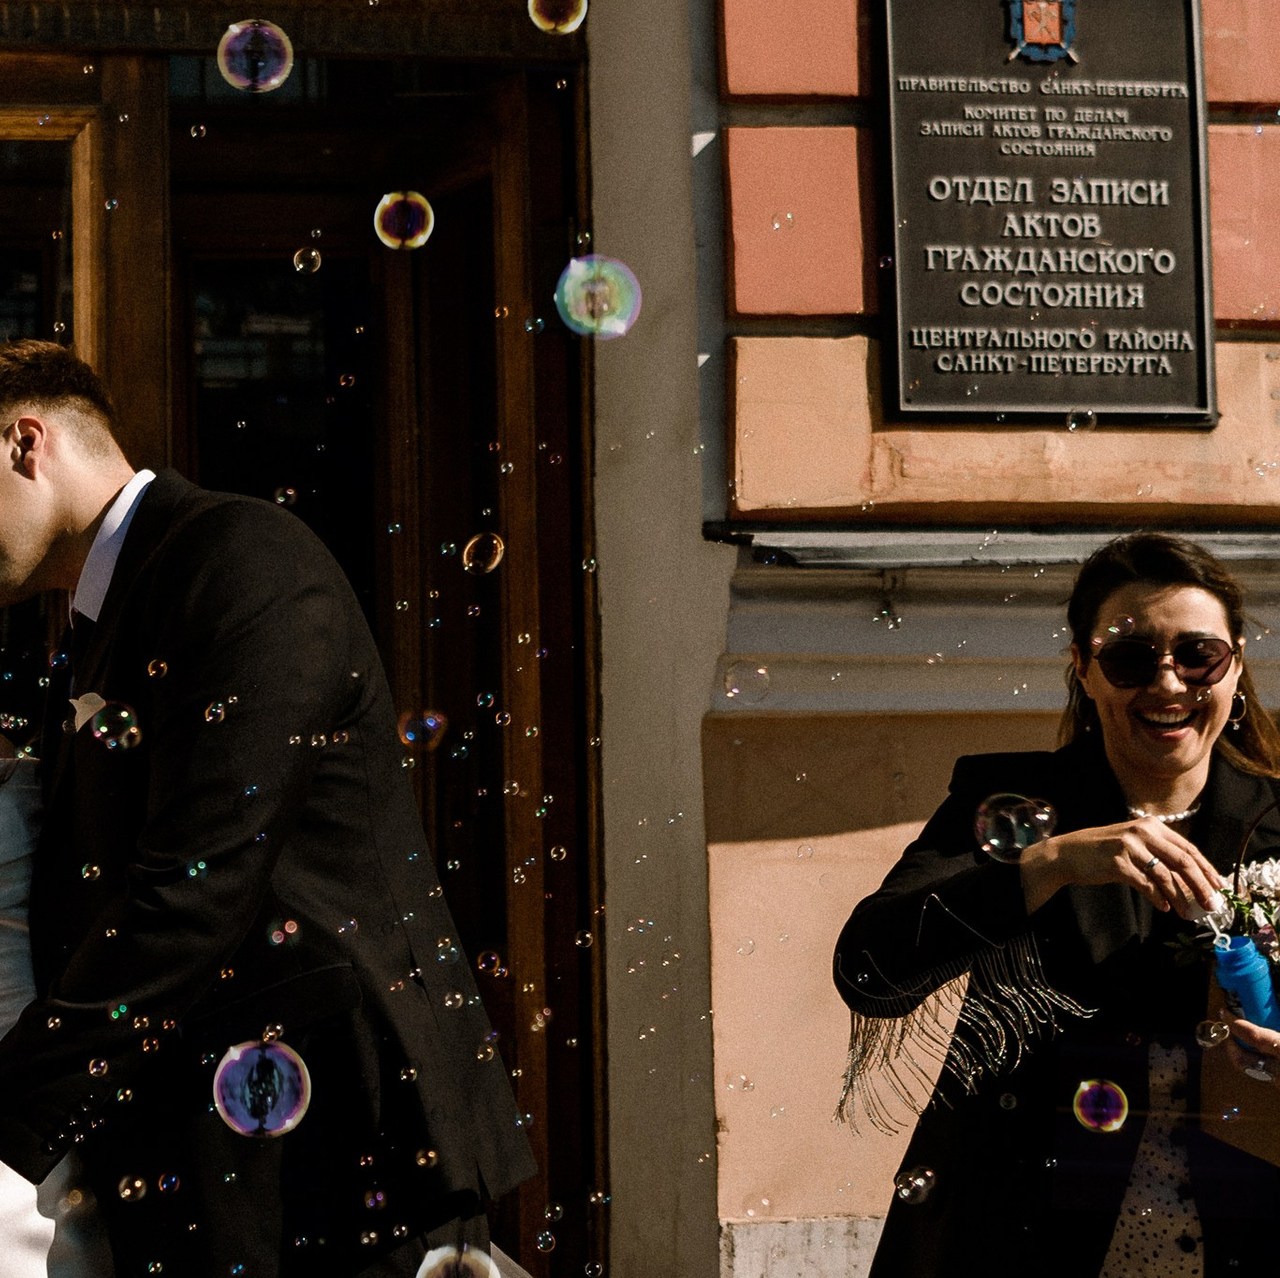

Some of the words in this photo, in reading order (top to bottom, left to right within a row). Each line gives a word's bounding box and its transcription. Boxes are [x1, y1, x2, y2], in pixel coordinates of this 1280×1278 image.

[898, 77, 1031, 94] ПРАВИТЕЛЬСТВО
[1040, 80, 1189, 98] САНКТ-ПЕТЕРБУРГА
[964, 105, 1037, 121] КОМИТЕТ
[1045, 107, 1066, 121] ПО
[1074, 108, 1129, 123] ДЕЛАМ
[920, 123, 984, 137] ЗАПИСИ
[992, 124, 1041, 138] АКТОВ
[1048, 125, 1172, 142] ГРАЖДАНСКОГО
[1000, 143, 1096, 157] СОСТОЯНИЯ
[929, 176, 1034, 205] ОТДЕЛ
[1052, 178, 1169, 205] ЗАПИСИ
[1002, 212, 1102, 238] АКТОВ
[924, 245, 1176, 275] ГРАЖДАНСКОГО
[961, 281, 1144, 308] СОСТОЯНИЯ
[911, 327, 1096, 350] ЦЕНТРАЛЬНОГО
[1108, 327, 1195, 350] РАЙОНА
